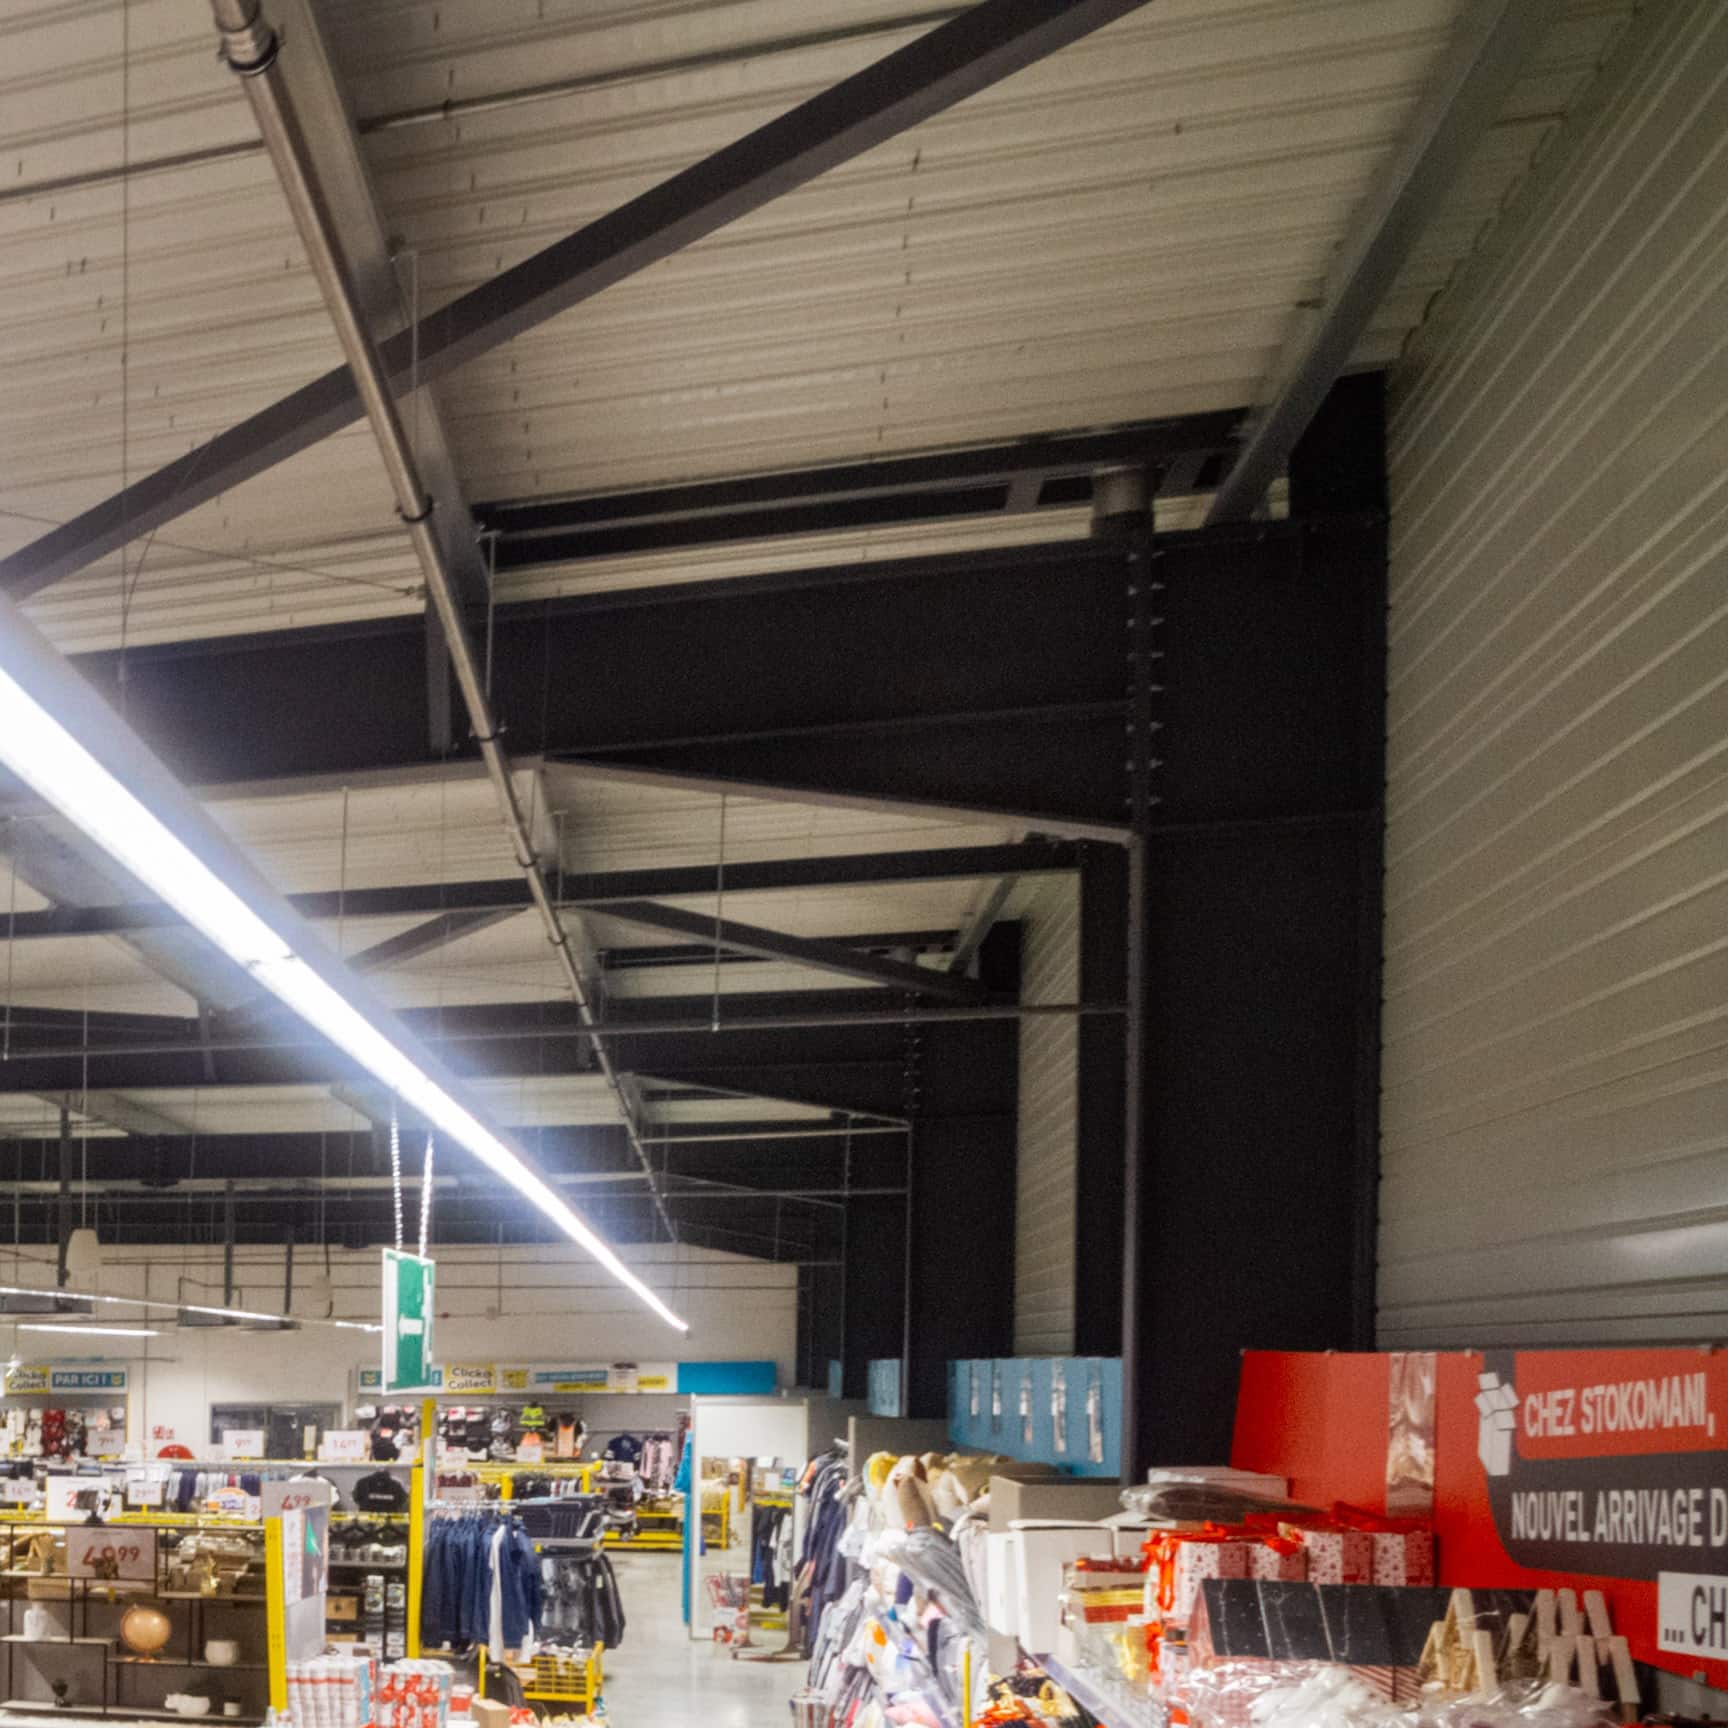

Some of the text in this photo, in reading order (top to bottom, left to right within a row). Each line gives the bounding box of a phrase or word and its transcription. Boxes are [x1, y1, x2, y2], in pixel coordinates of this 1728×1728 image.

[55, 1374, 78, 1385] PAR
[80, 1374, 98, 1385] ICI
[448, 1379, 492, 1389] Collect
[1524, 1372, 1715, 1437] CHEZ STOKOMANI,
[1511, 1490, 1590, 1542] NOUVEL
[1593, 1487, 1704, 1547] ARRIVAGE
